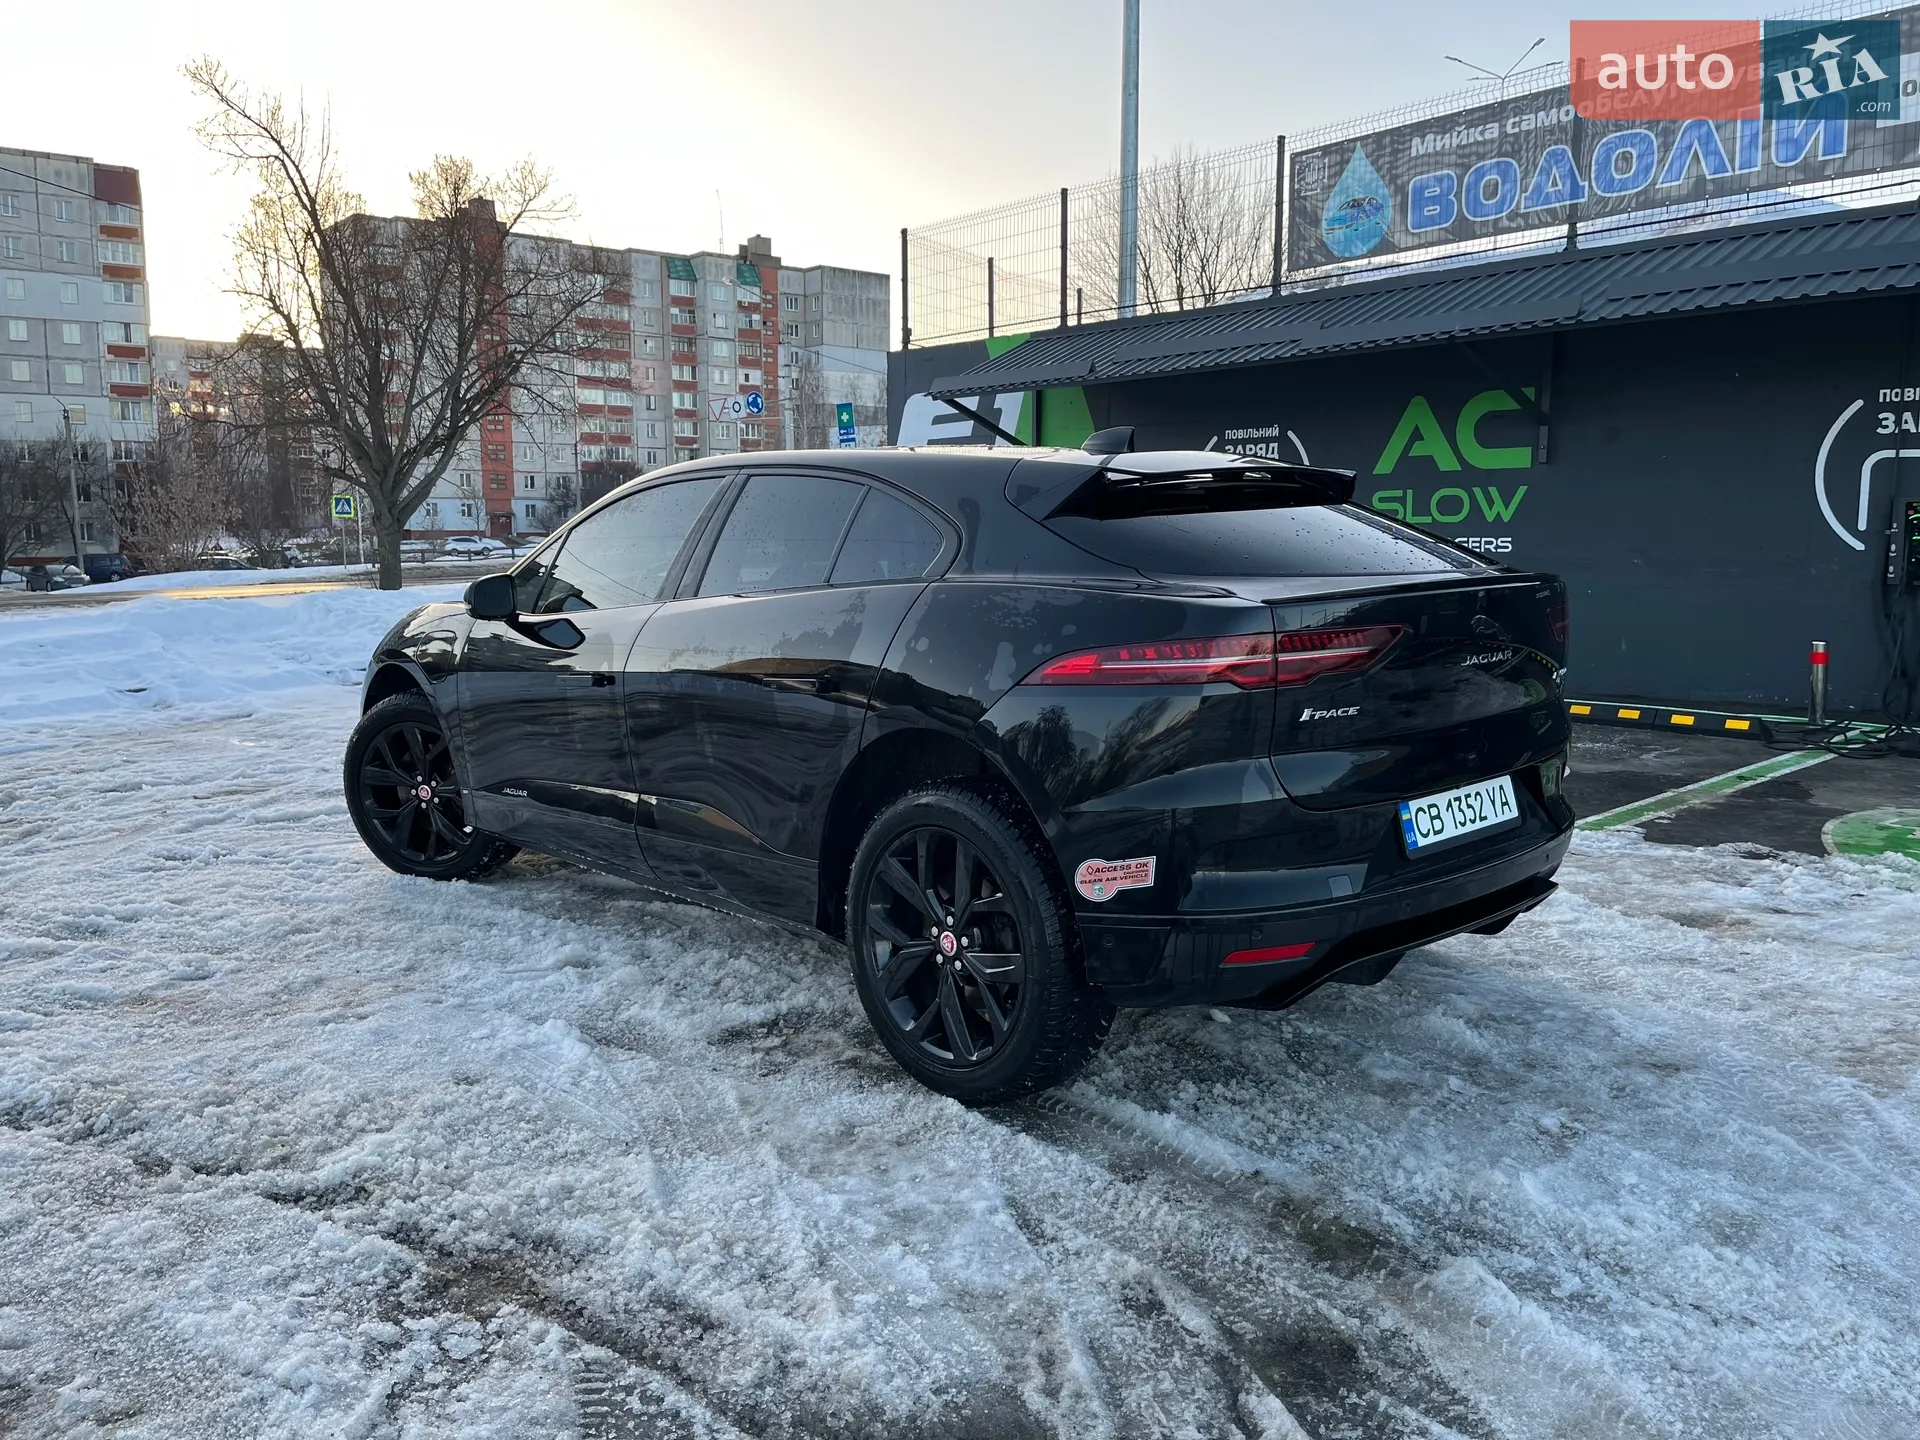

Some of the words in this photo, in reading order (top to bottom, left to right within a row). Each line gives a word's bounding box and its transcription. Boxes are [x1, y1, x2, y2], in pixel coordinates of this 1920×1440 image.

[1410, 121, 1499, 157] Мийка
[1372, 386, 1536, 475] AC
[1875, 411, 1920, 434] ЗА
[1225, 424, 1279, 440] ПОВІЛЬНИЙ
[1371, 485, 1528, 524] SLOW
[1461, 650, 1513, 666] JAGUAR
[501, 787, 528, 797] JAGUAR
[1415, 803, 1445, 839] CB
[1446, 790, 1489, 830] 1352
[1485, 784, 1513, 819] YA
[1405, 832, 1417, 843] UA
[1094, 864, 1132, 874] ACCESS
[1135, 861, 1149, 870] OK
[1119, 872, 1149, 881] VEHICLE
